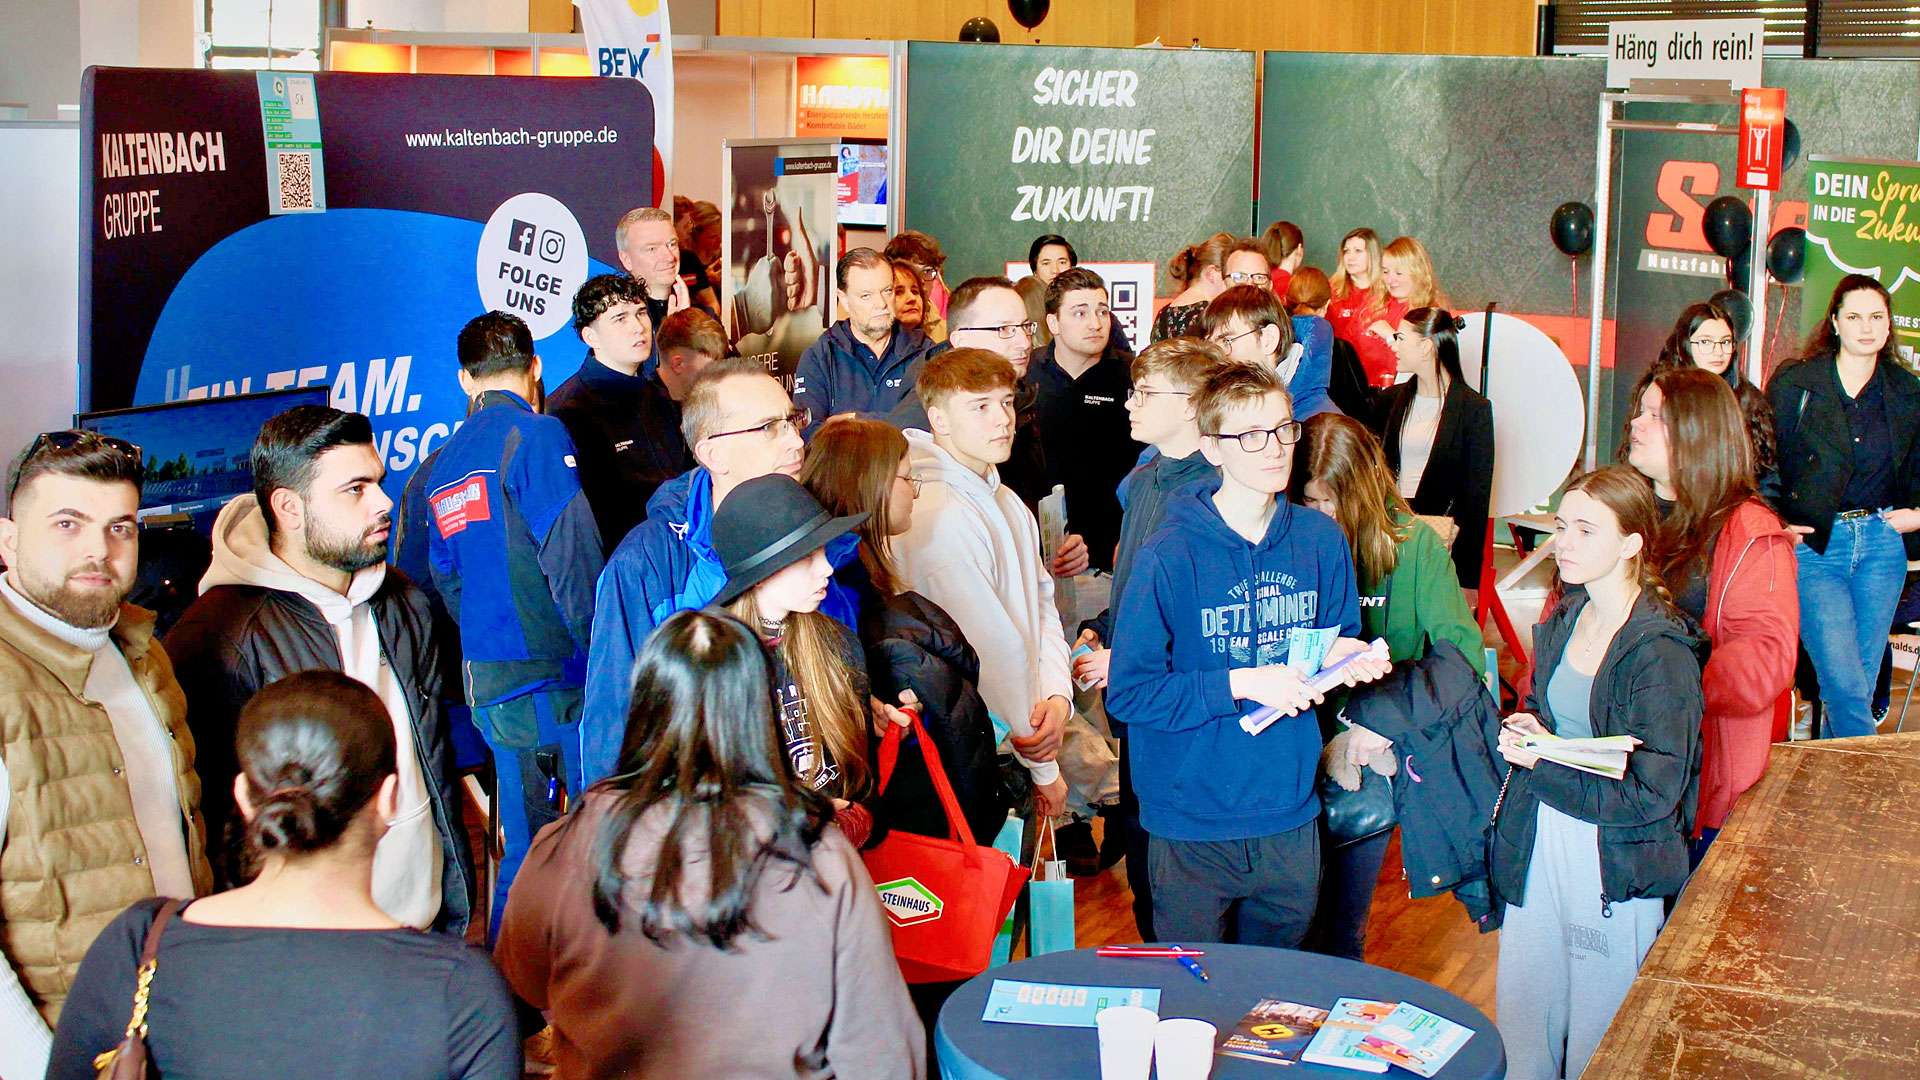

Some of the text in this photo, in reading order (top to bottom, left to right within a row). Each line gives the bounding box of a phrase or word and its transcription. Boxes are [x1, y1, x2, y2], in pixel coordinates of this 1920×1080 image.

[1615, 31, 1754, 68] Häng dich rein!
[1032, 66, 1139, 108] SICHER
[102, 131, 227, 178] KALTENBACH
[405, 125, 618, 148] www.kaltenbach-gruppe.de
[1011, 126, 1156, 165] DIR DEINE
[1010, 185, 1155, 222] ZUKUNFT!
[1815, 172, 1869, 199] DEIN
[103, 189, 163, 240] GRUPPE
[1813, 204, 1829, 221] IN
[1831, 205, 1856, 223] DIE
[498, 261, 563, 296] FOLGE
[506, 289, 546, 316] UNS
[882, 892, 931, 913] STEINHAUS
